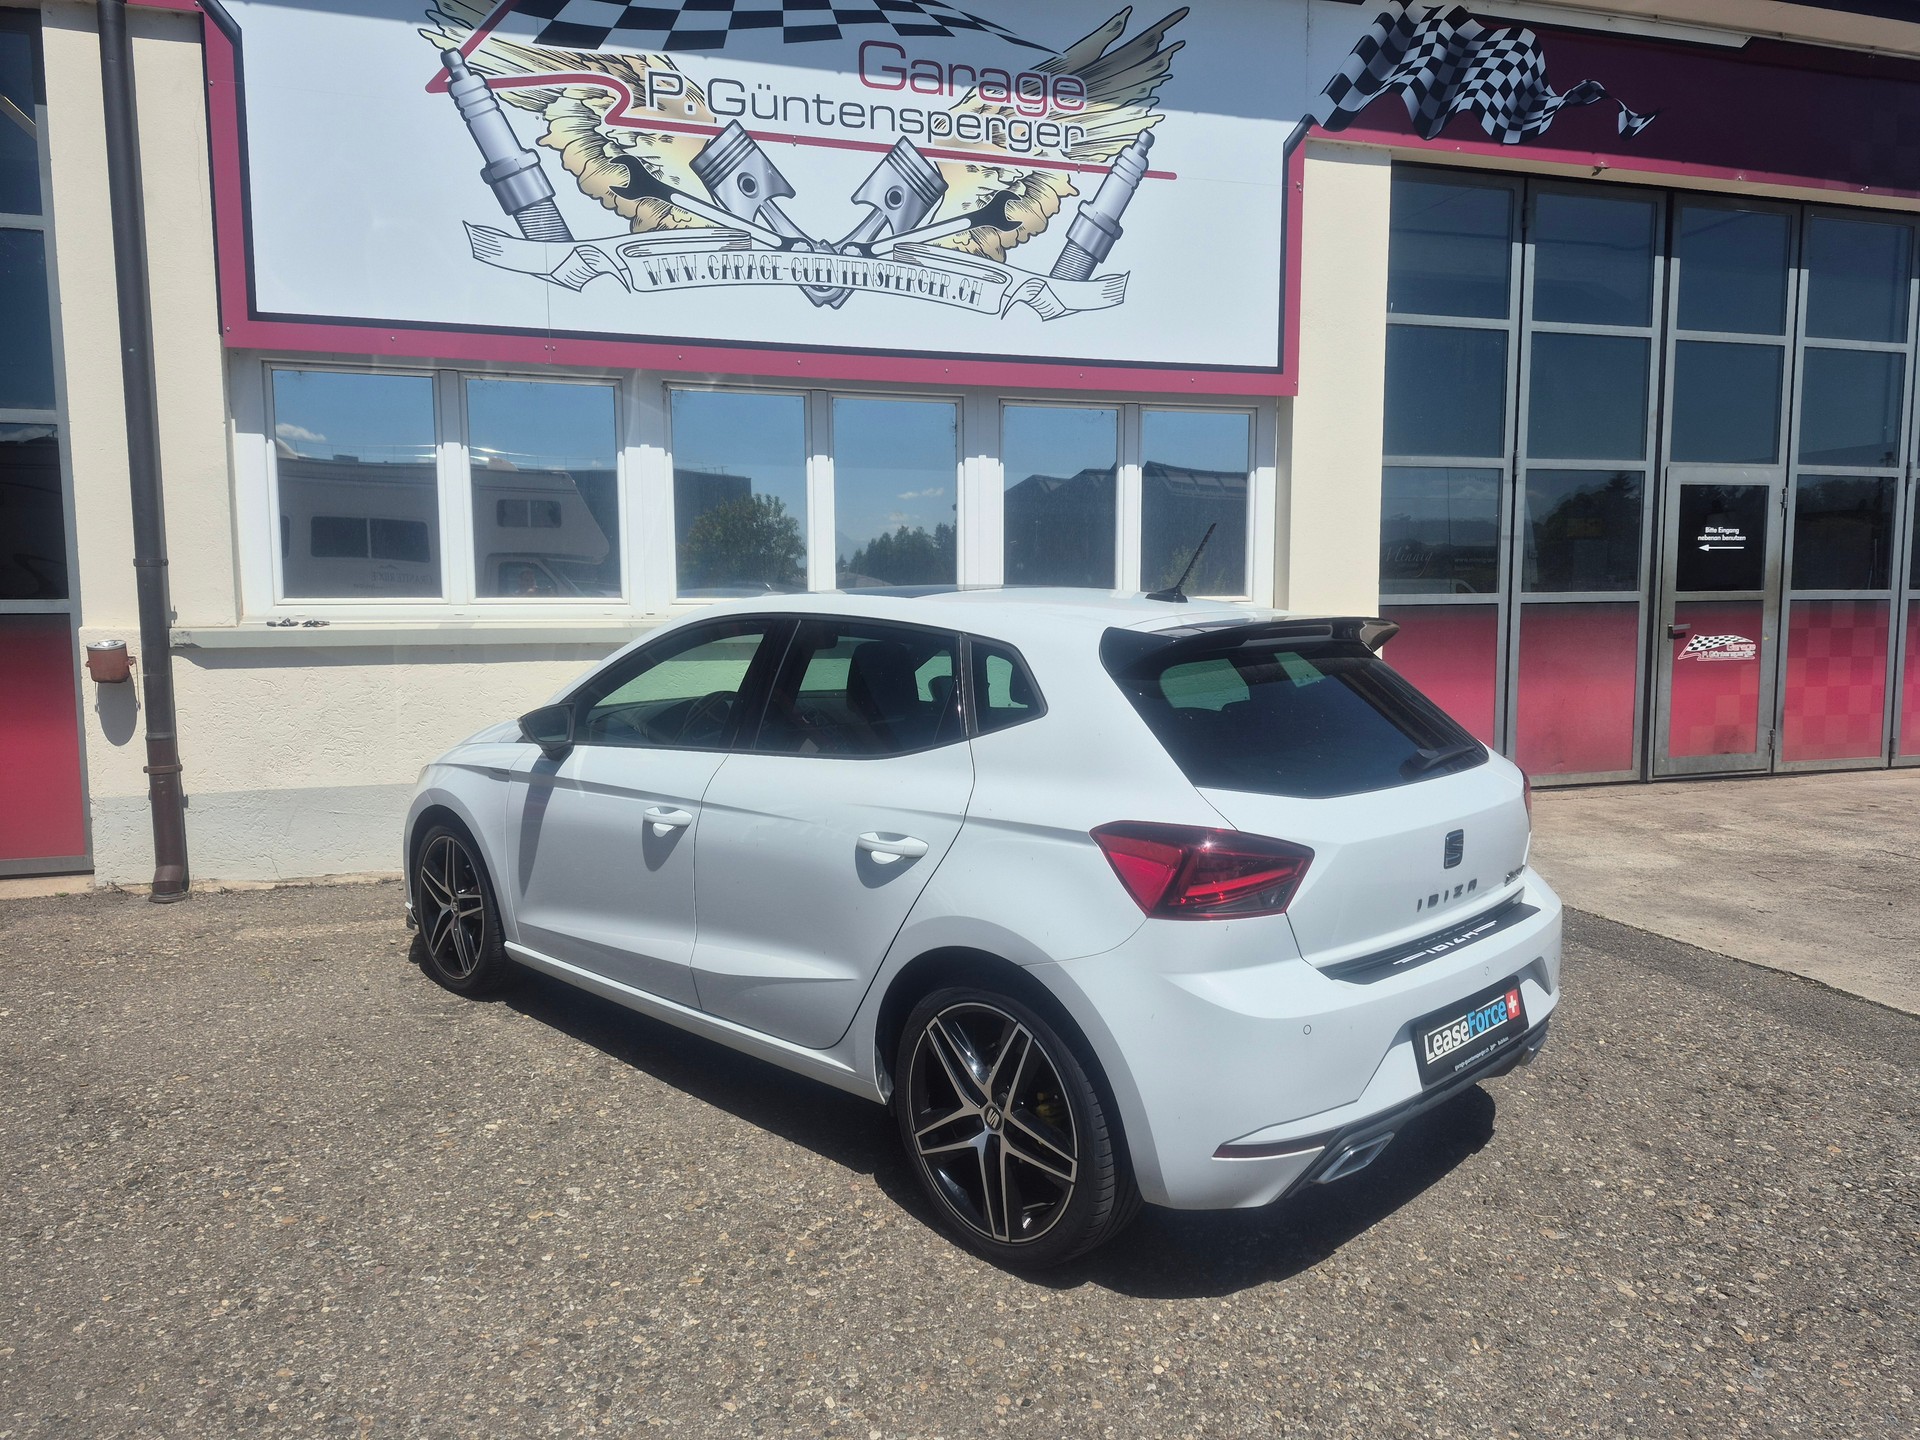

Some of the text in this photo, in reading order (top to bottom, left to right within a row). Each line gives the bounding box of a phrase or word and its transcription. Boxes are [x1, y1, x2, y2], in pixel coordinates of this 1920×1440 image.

[859, 40, 1086, 117] Garage
[708, 78, 1085, 152] Güntensperger
[643, 254, 984, 306] WWW.GARAGE-GUENTENSPERGER.CH
[1704, 526, 1740, 535] Bitte Eingang
[1416, 878, 1478, 912] IBIZA
[1424, 999, 1507, 1061] LeaseForce
